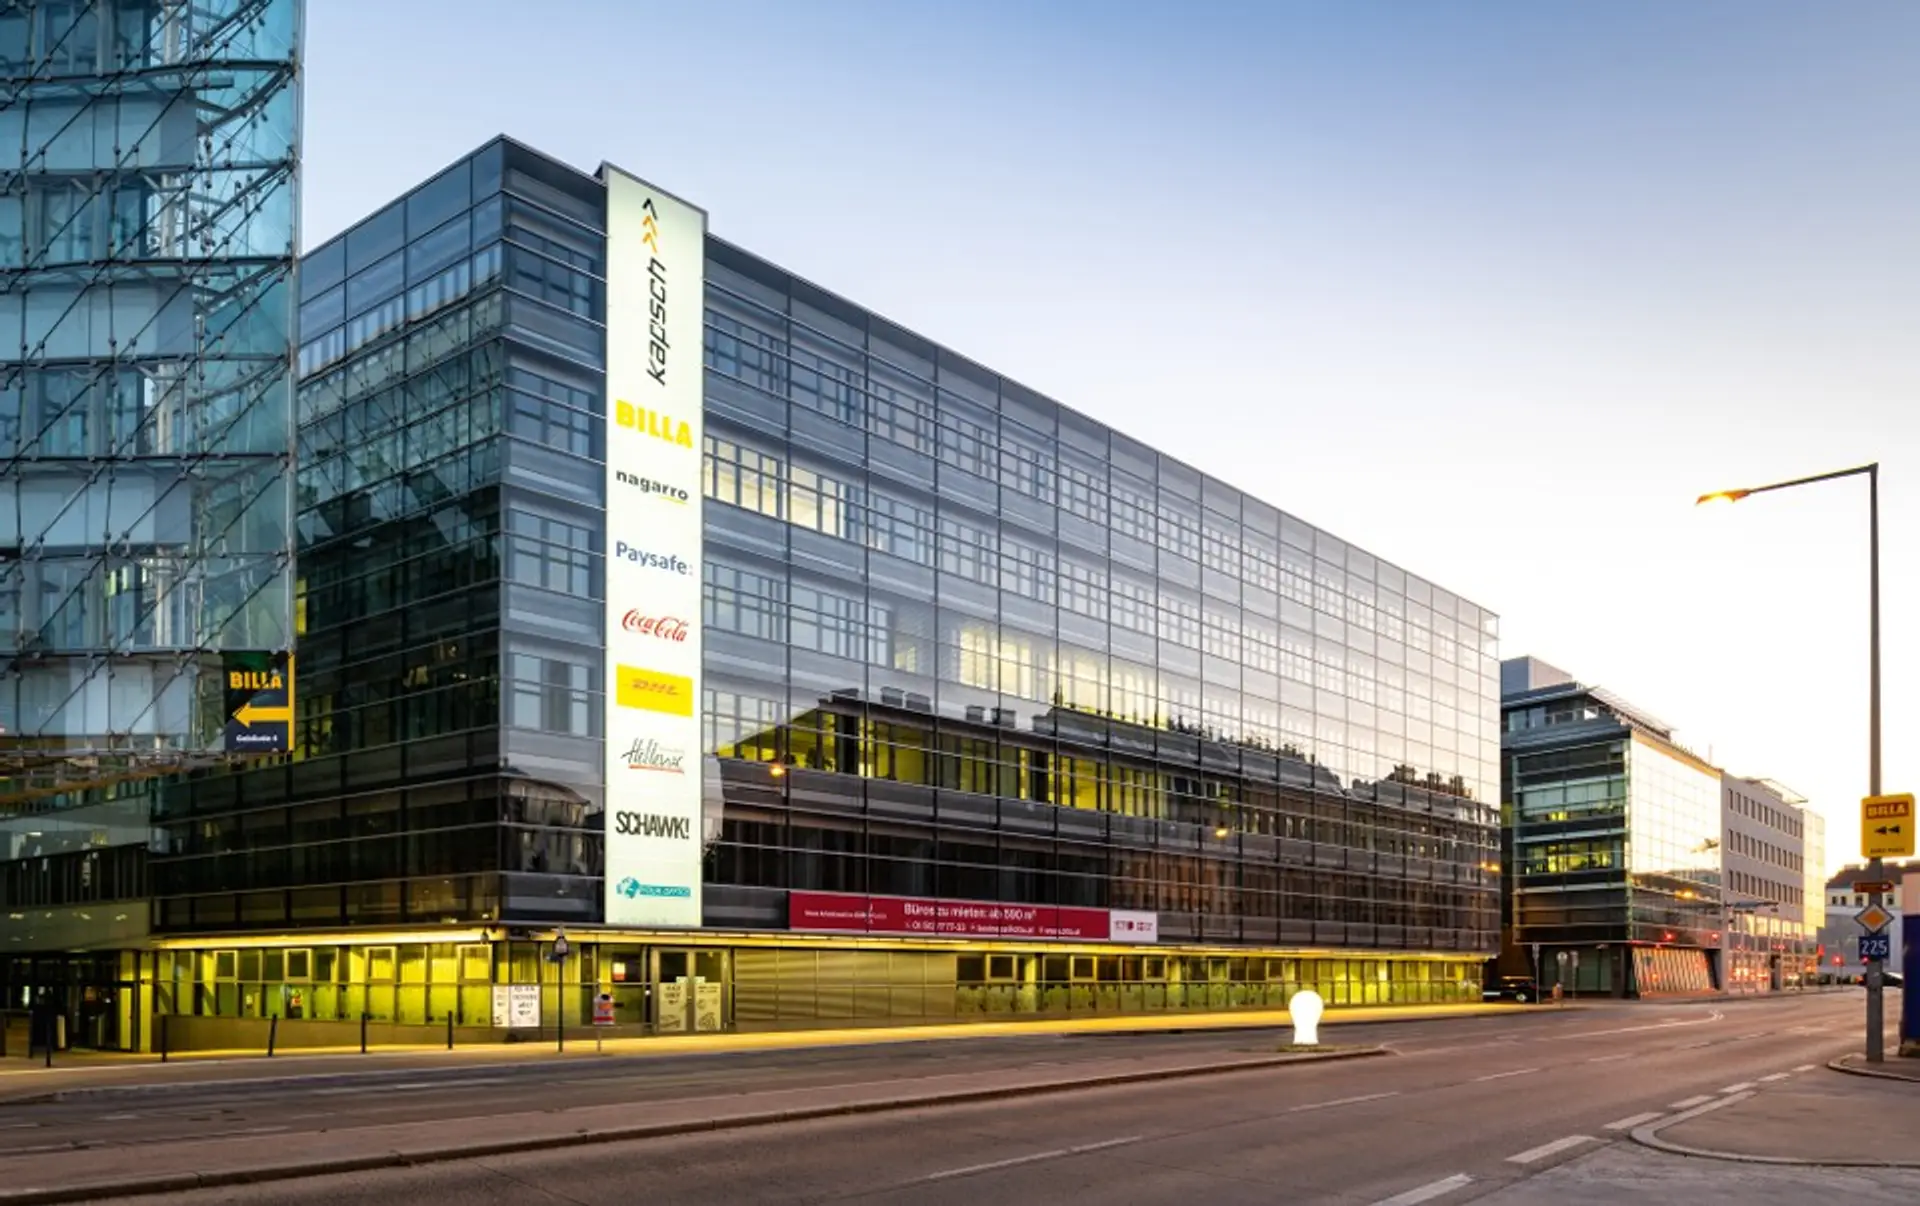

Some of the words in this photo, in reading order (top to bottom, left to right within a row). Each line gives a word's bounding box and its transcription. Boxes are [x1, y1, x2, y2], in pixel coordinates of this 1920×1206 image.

[616, 399, 693, 449] BILLA
[616, 470, 689, 501] nagarro
[230, 672, 283, 689] BILLA
[1867, 803, 1906, 817] BILLA
[615, 811, 689, 839] SCHAWK!
[1861, 940, 1888, 956] 225
